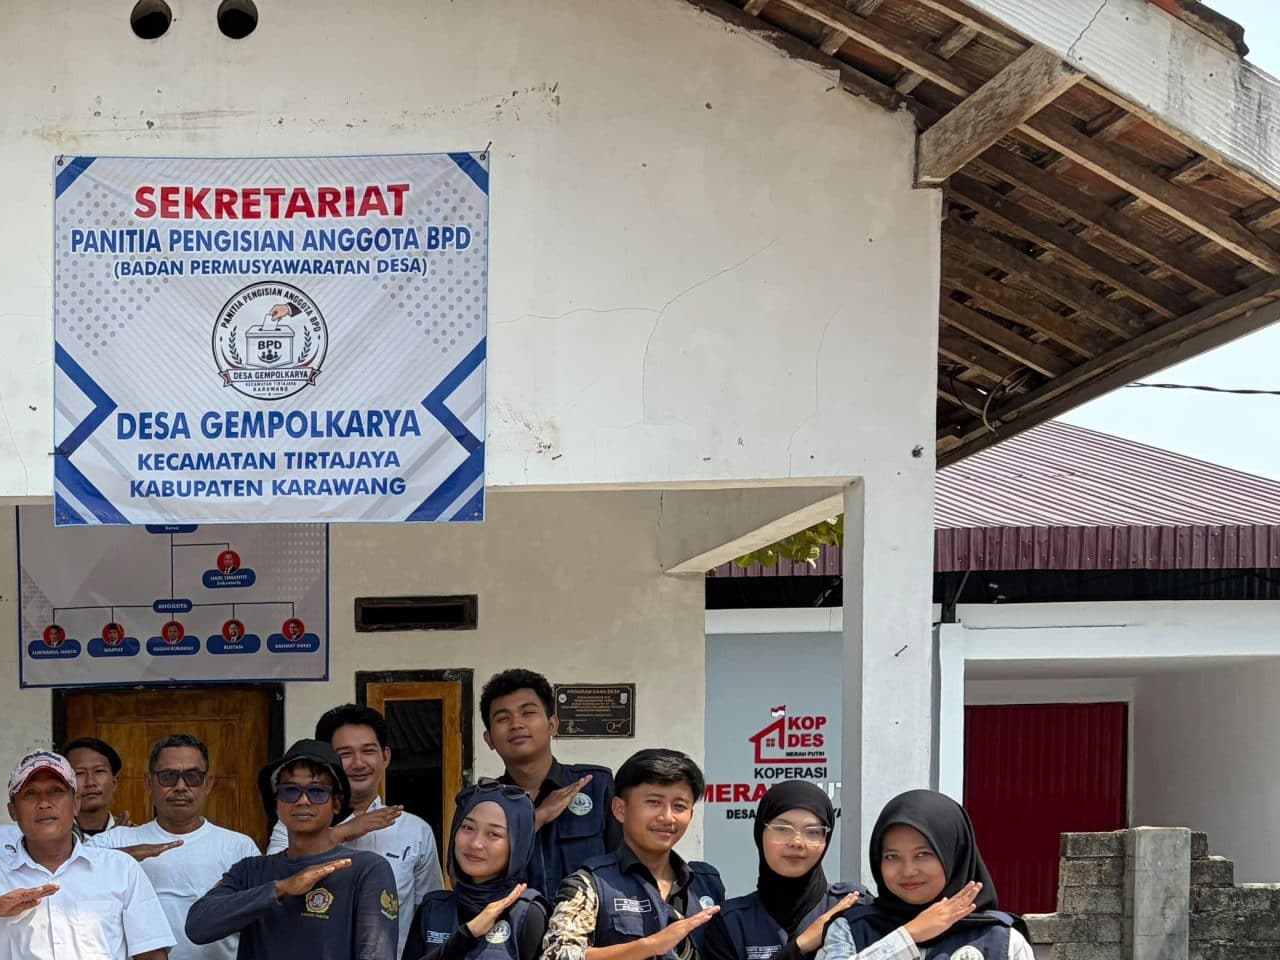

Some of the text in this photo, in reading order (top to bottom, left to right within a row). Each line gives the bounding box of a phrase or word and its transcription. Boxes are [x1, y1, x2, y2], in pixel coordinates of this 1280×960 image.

[134, 183, 410, 219] SEKRETARIAT
[71, 226, 471, 254] PANITIA PENGISIAN ANGGOTA BPD
[114, 257, 428, 279] (BADAN PERMUSYAWARATAN DESA)
[221, 288, 322, 332] PANITIA PENGISIAN ANGGOTA BPD
[257, 340, 282, 350] BPD
[233, 370, 308, 380] DESA GEMPOLKARYA
[117, 410, 422, 440] DESA GEMPOLKARYA
[137, 450, 401, 472] KECAMATAN TIRTAJAYA
[130, 477, 407, 498] KABUPATEN KARAWANG
[788, 716, 827, 730] KOP
[788, 734, 824, 748] DES
[754, 767, 827, 779] KOPERASI
[703, 783, 778, 803] MERA
[726, 809, 757, 819] DESA
